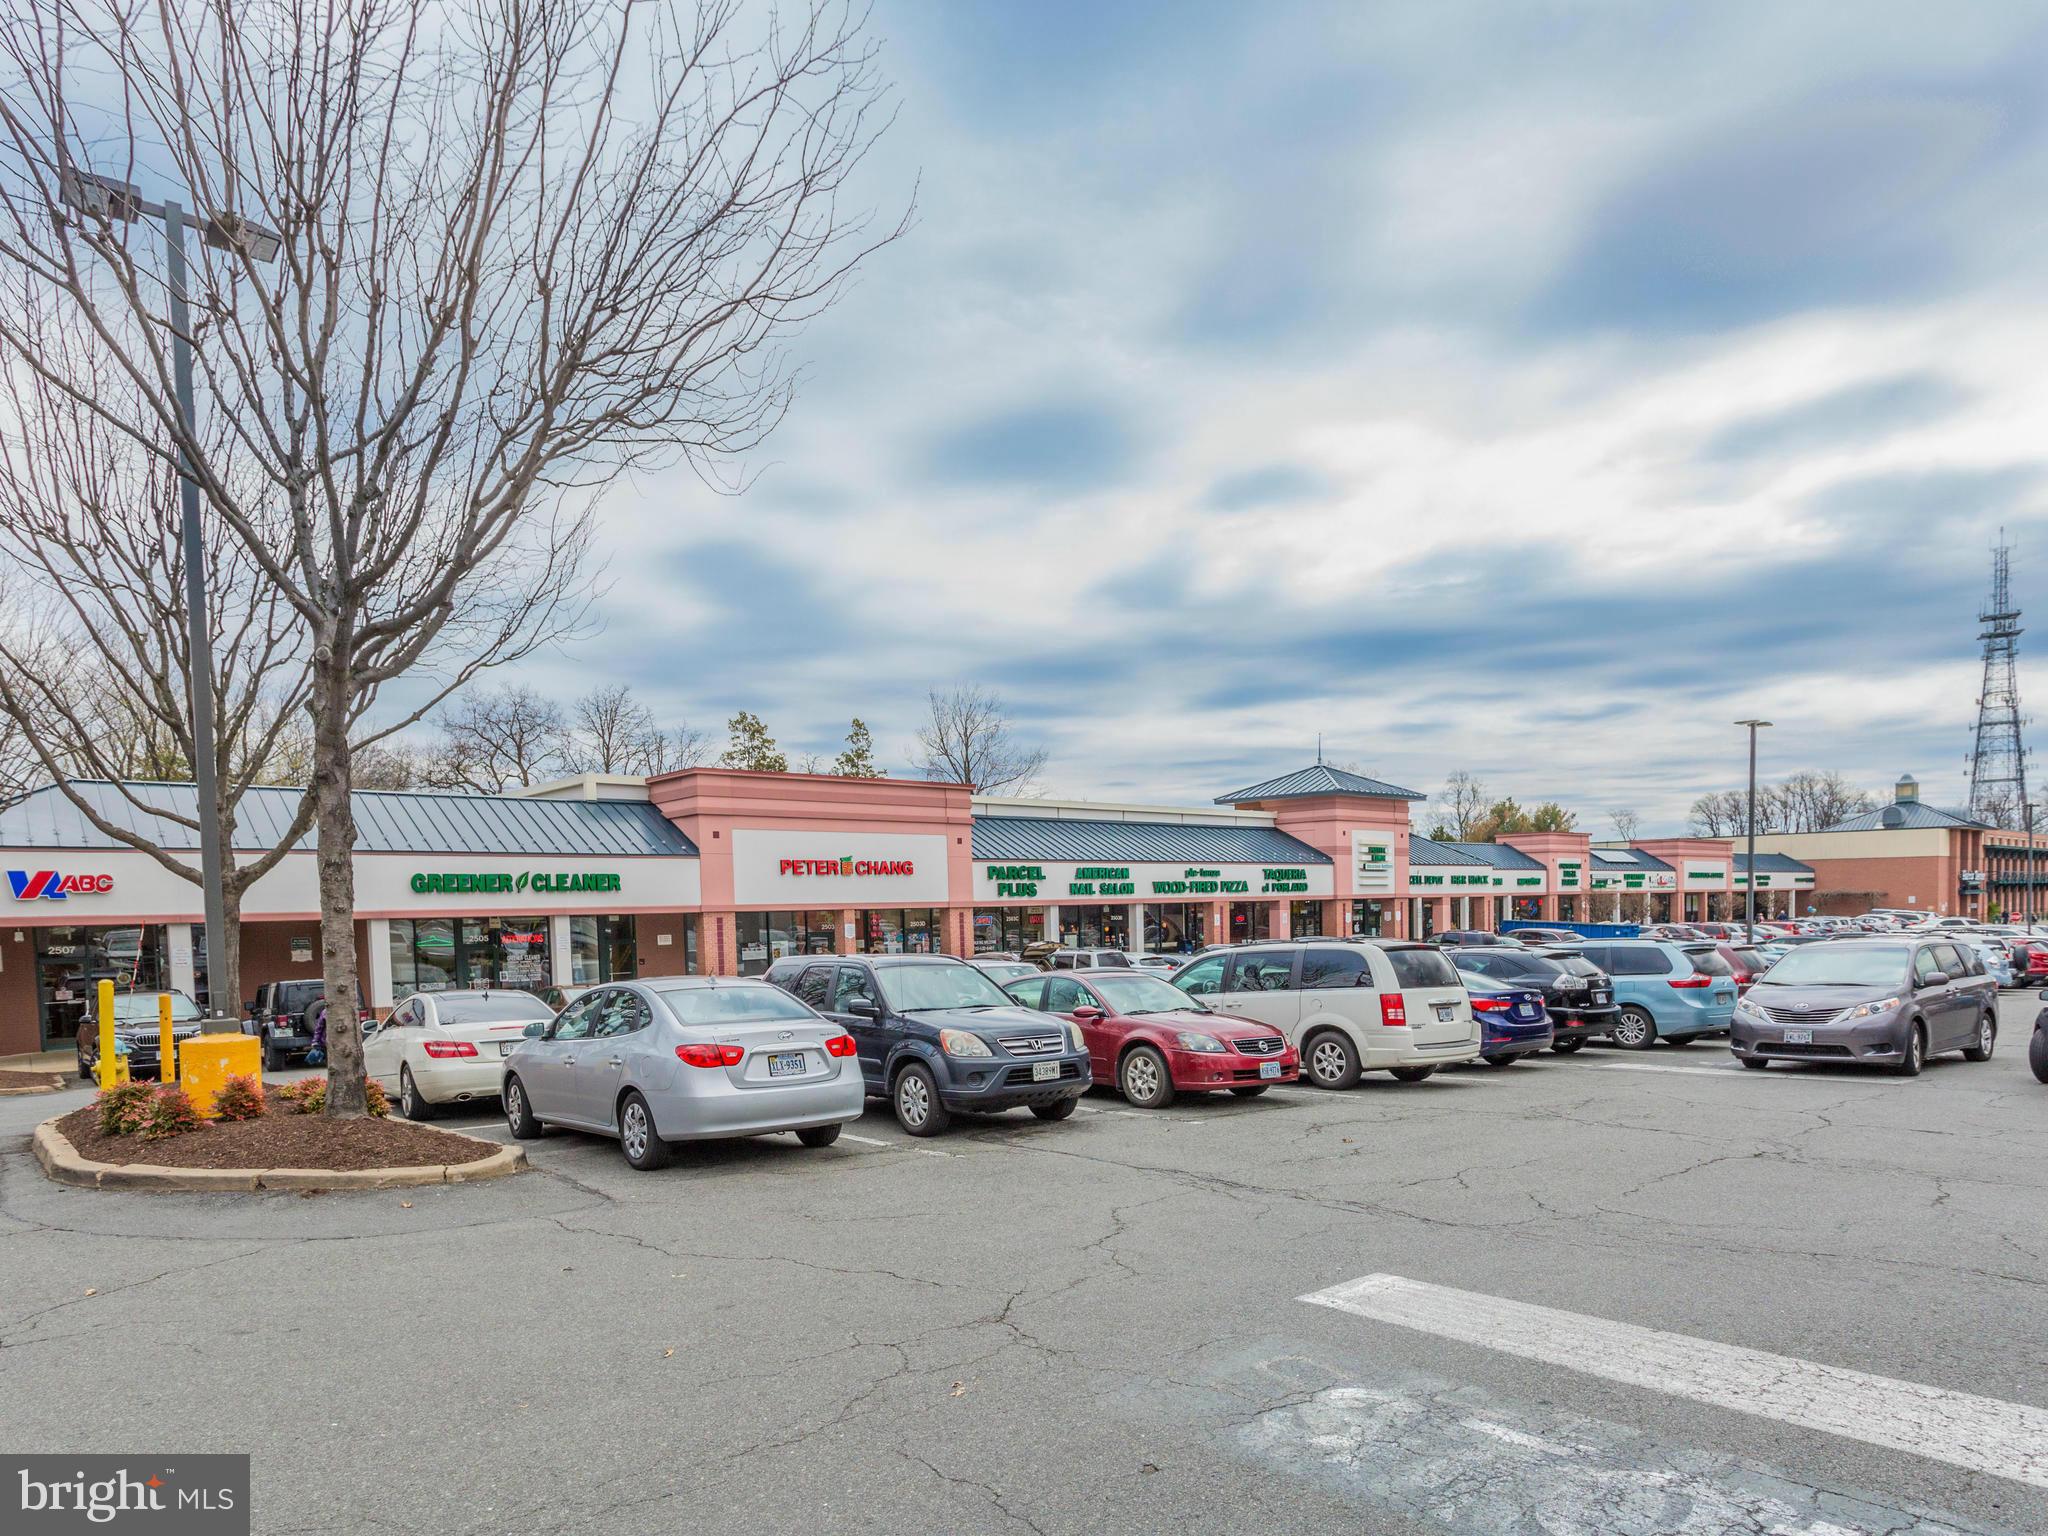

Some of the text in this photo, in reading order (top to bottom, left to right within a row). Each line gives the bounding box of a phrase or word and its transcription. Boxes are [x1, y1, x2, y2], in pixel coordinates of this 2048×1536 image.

[780, 859, 914, 876] PETER CHANG
[987, 865, 1046, 880] PARCEL
[1074, 867, 1130, 879] AMERICAN
[1262, 868, 1307, 881] TAQUERIA
[57, 874, 113, 893] ABC
[411, 873, 621, 893] GREENER CLEANER
[998, 882, 1037, 897] PLUS
[1069, 882, 1135, 895] NAIL SALON
[1152, 880, 1249, 893] WOOD-FIRED PIZZA
[469, 935, 489, 943] 2505
[48, 946, 76, 955] 2507
